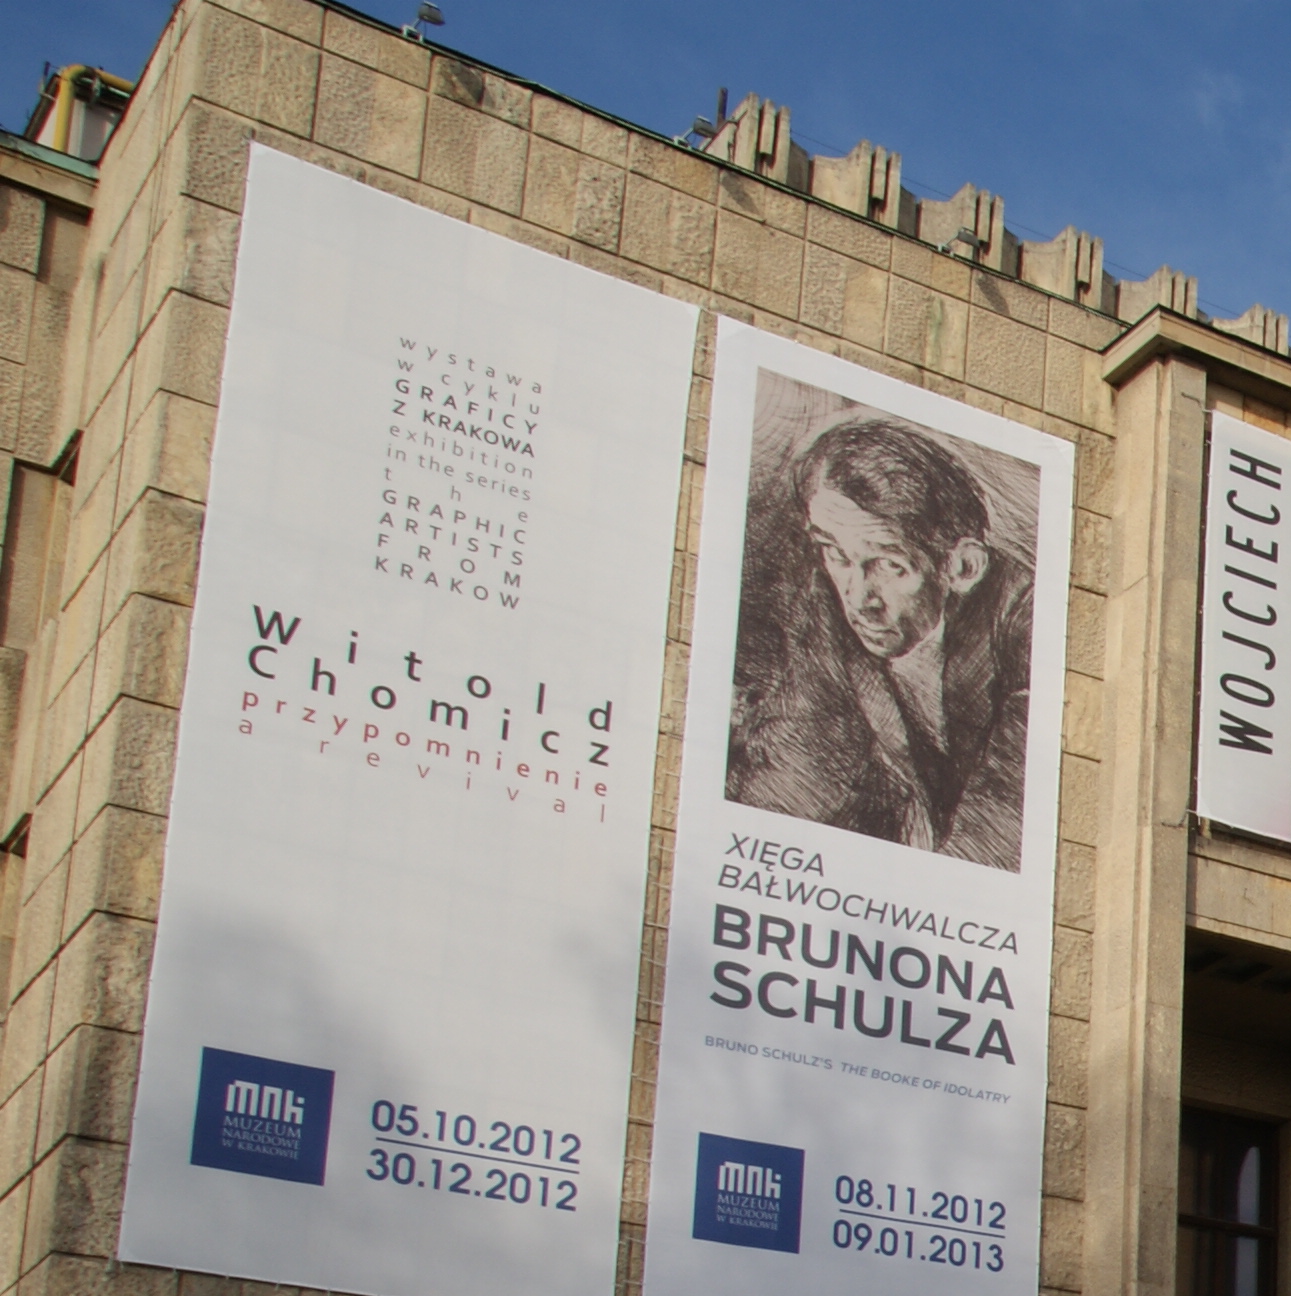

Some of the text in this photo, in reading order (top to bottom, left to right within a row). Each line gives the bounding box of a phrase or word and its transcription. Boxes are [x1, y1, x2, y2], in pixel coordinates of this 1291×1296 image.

[397, 358, 540, 415] w cyklu
[400, 337, 542, 393] wystawa
[392, 399, 536, 458] Z KRAKOWA
[395, 378, 538, 435] GRAFICY
[387, 443, 531, 501] in the series
[389, 424, 533, 479] exhibition
[379, 512, 523, 566] ARTISTS
[382, 489, 526, 544] GRAPHIC
[375, 556, 520, 610] KRAKOW
[377, 533, 521, 588] FROM
[1219, 448, 1283, 756] WOJCIECH
[253, 604, 613, 732] Witold
[248, 645, 610, 767] Chomicz
[238, 718, 605, 824] a revival
[241, 690, 608, 797] przypomnienie
[725, 832, 825, 877] XIĘGA
[718, 864, 1018, 955] BAŁWOCHWALCZA
[713, 903, 1015, 1010] BRUNONA
[710, 961, 1016, 1065] SCHULZA
[705, 1035, 1011, 1104] BRUNO SCHULZ'S THE BOOKE OF IDOLATRY
[221, 1138, 300, 1160] W KRAKOWIE
[222, 1127, 301, 1150] NARODOWE
[223, 1115, 302, 1140] MUZEUM
[371, 1100, 582, 1165] 05.10.2012
[366, 1148, 579, 1212] 30.12.2012
[717, 1193, 780, 1212] MUZEUM
[835, 1175, 1006, 1230] 08.11.2012
[717, 1205, 779, 1222] NARODOWE
[832, 1219, 1004, 1273] 09.01.2013
